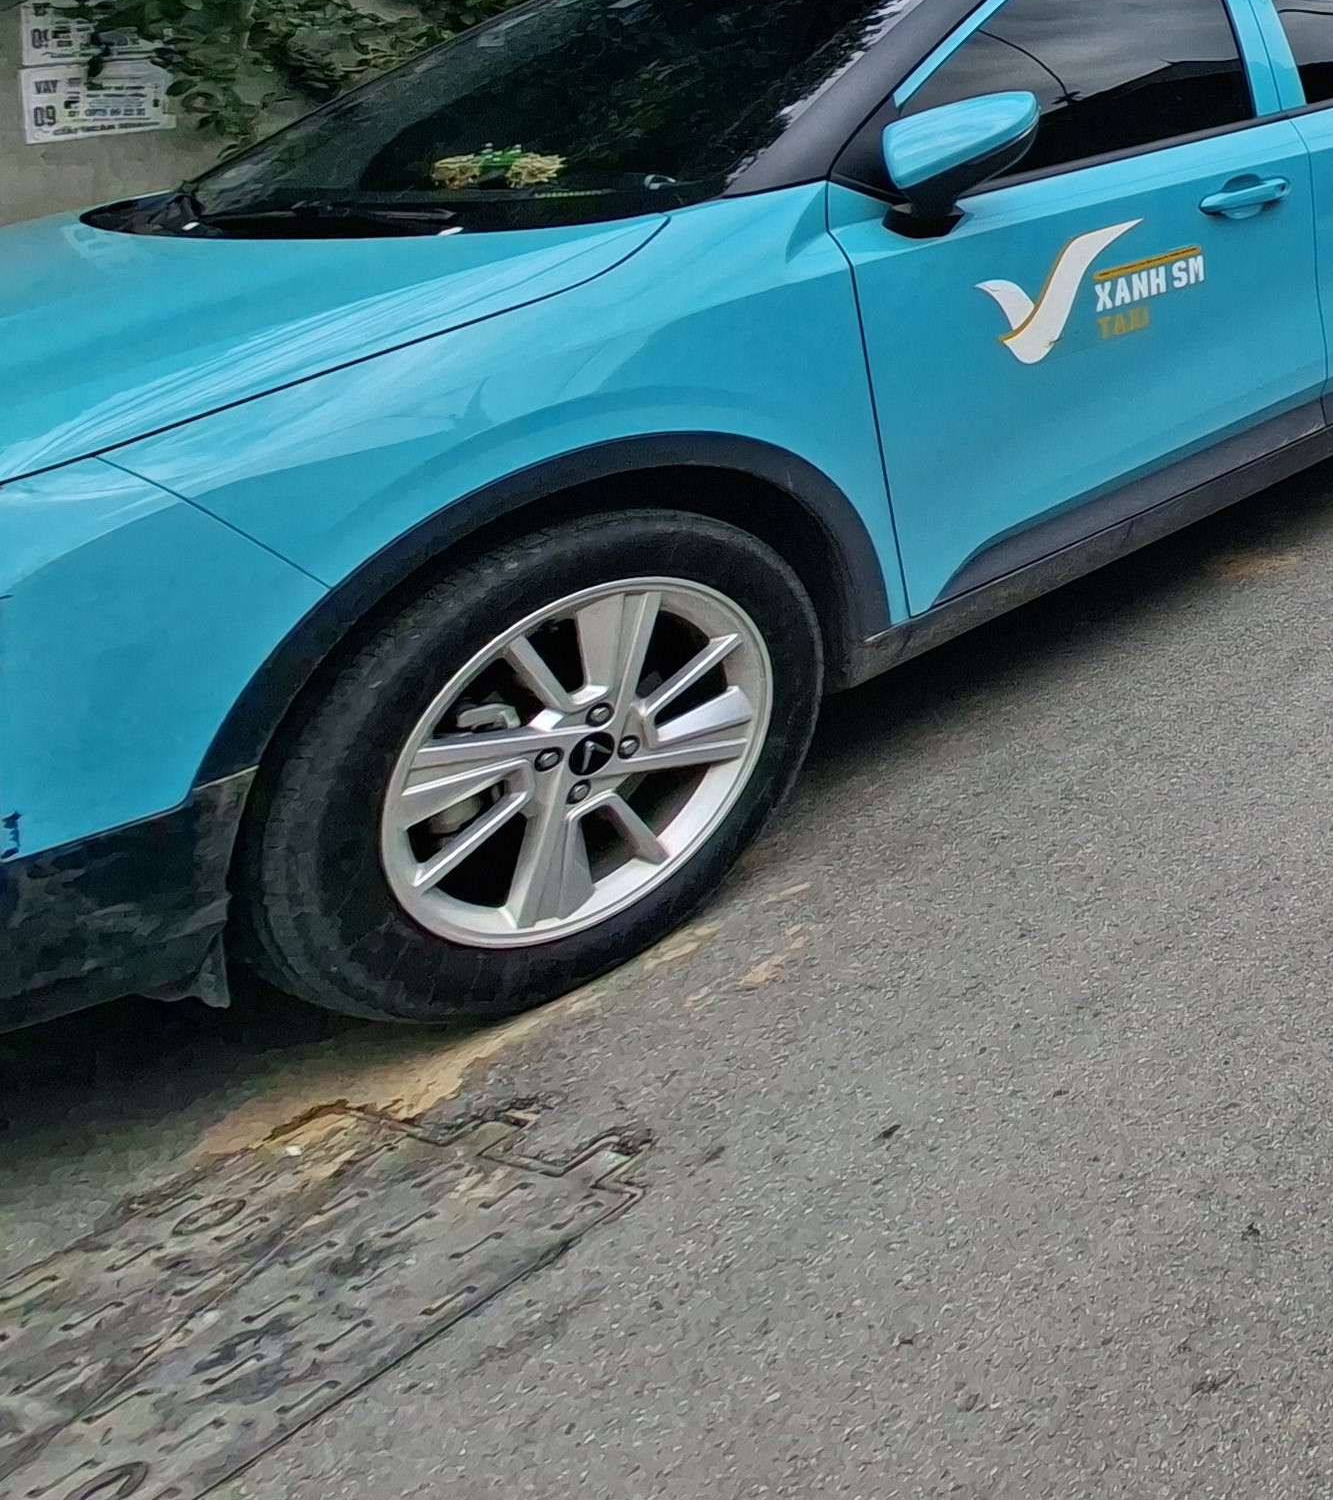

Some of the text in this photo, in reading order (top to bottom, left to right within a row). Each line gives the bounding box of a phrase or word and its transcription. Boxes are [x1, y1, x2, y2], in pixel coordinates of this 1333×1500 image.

[34, 80, 59, 95] VAY
[33, 105, 56, 127] 09
[1094, 254, 1205, 313] XANH SM
